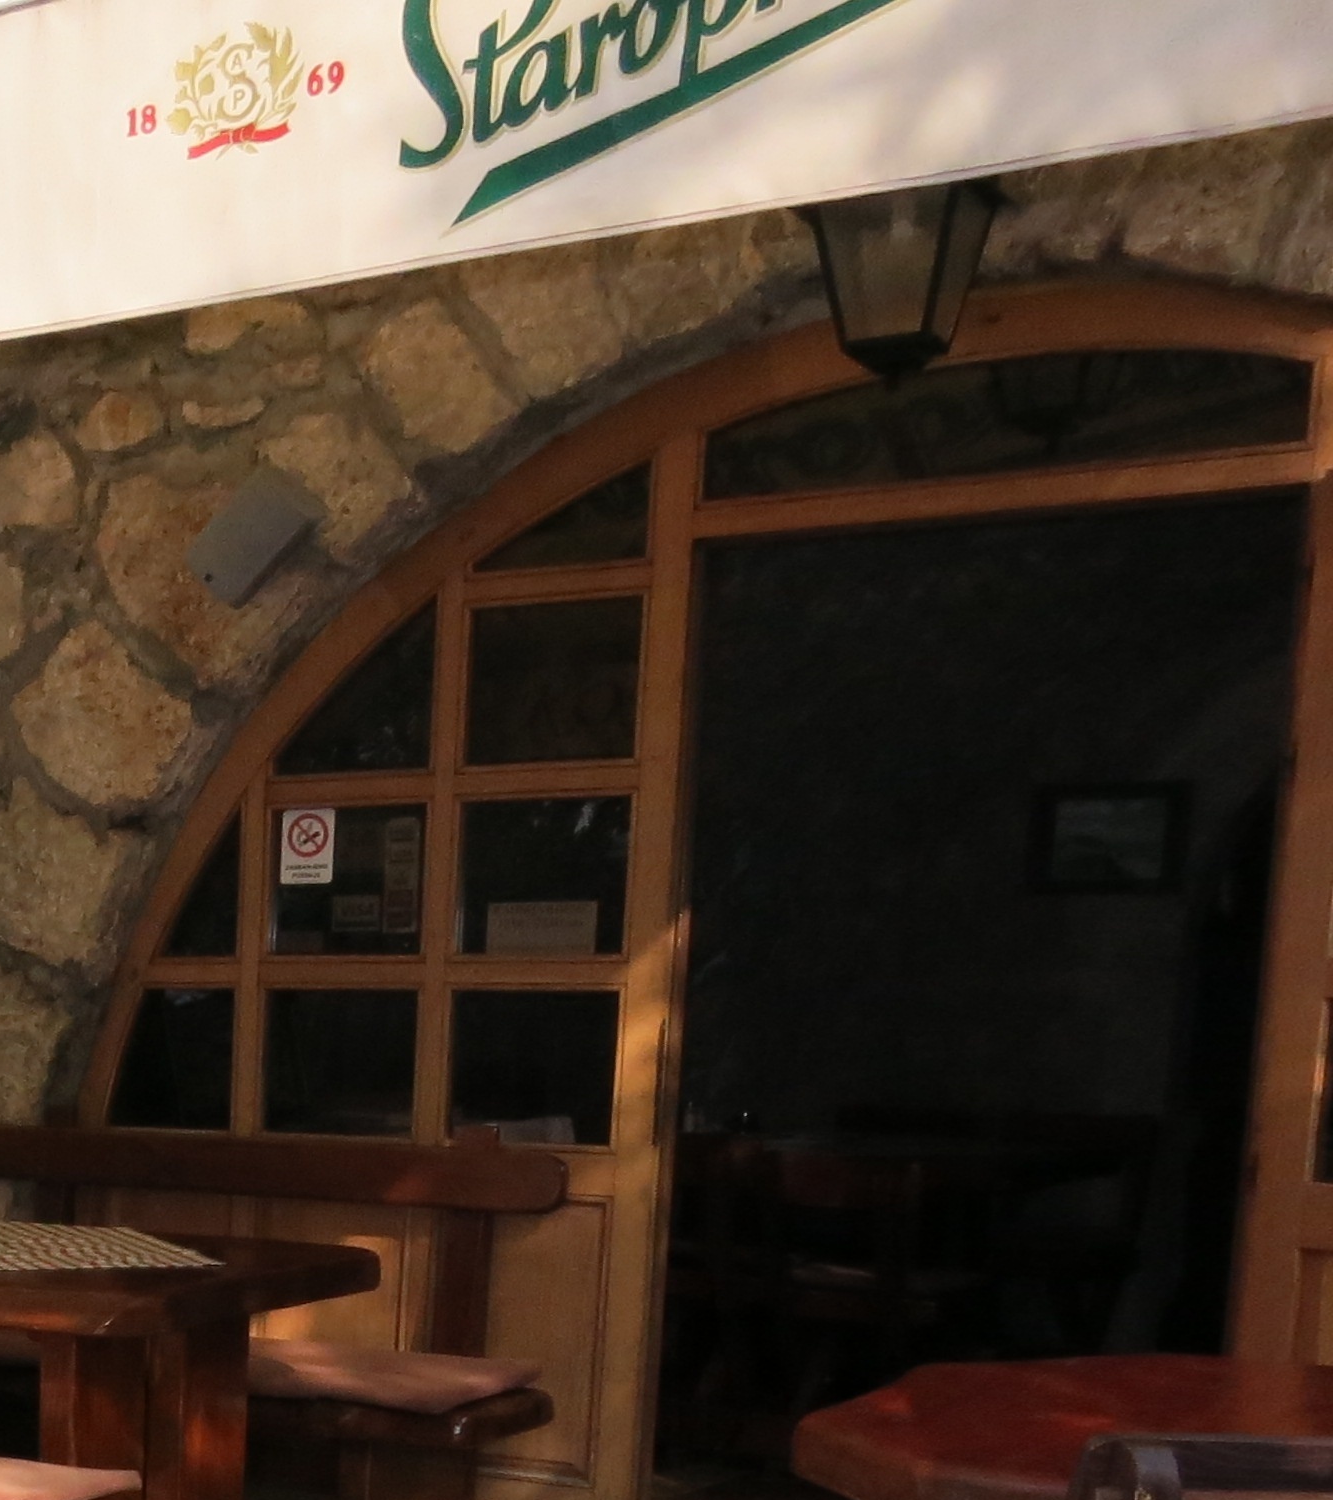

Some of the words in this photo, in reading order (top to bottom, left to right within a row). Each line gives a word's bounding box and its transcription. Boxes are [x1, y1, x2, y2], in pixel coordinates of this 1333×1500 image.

[126, 105, 157, 137] 18
[307, 61, 346, 97] 69
[399, 0, 786, 169] Starop
